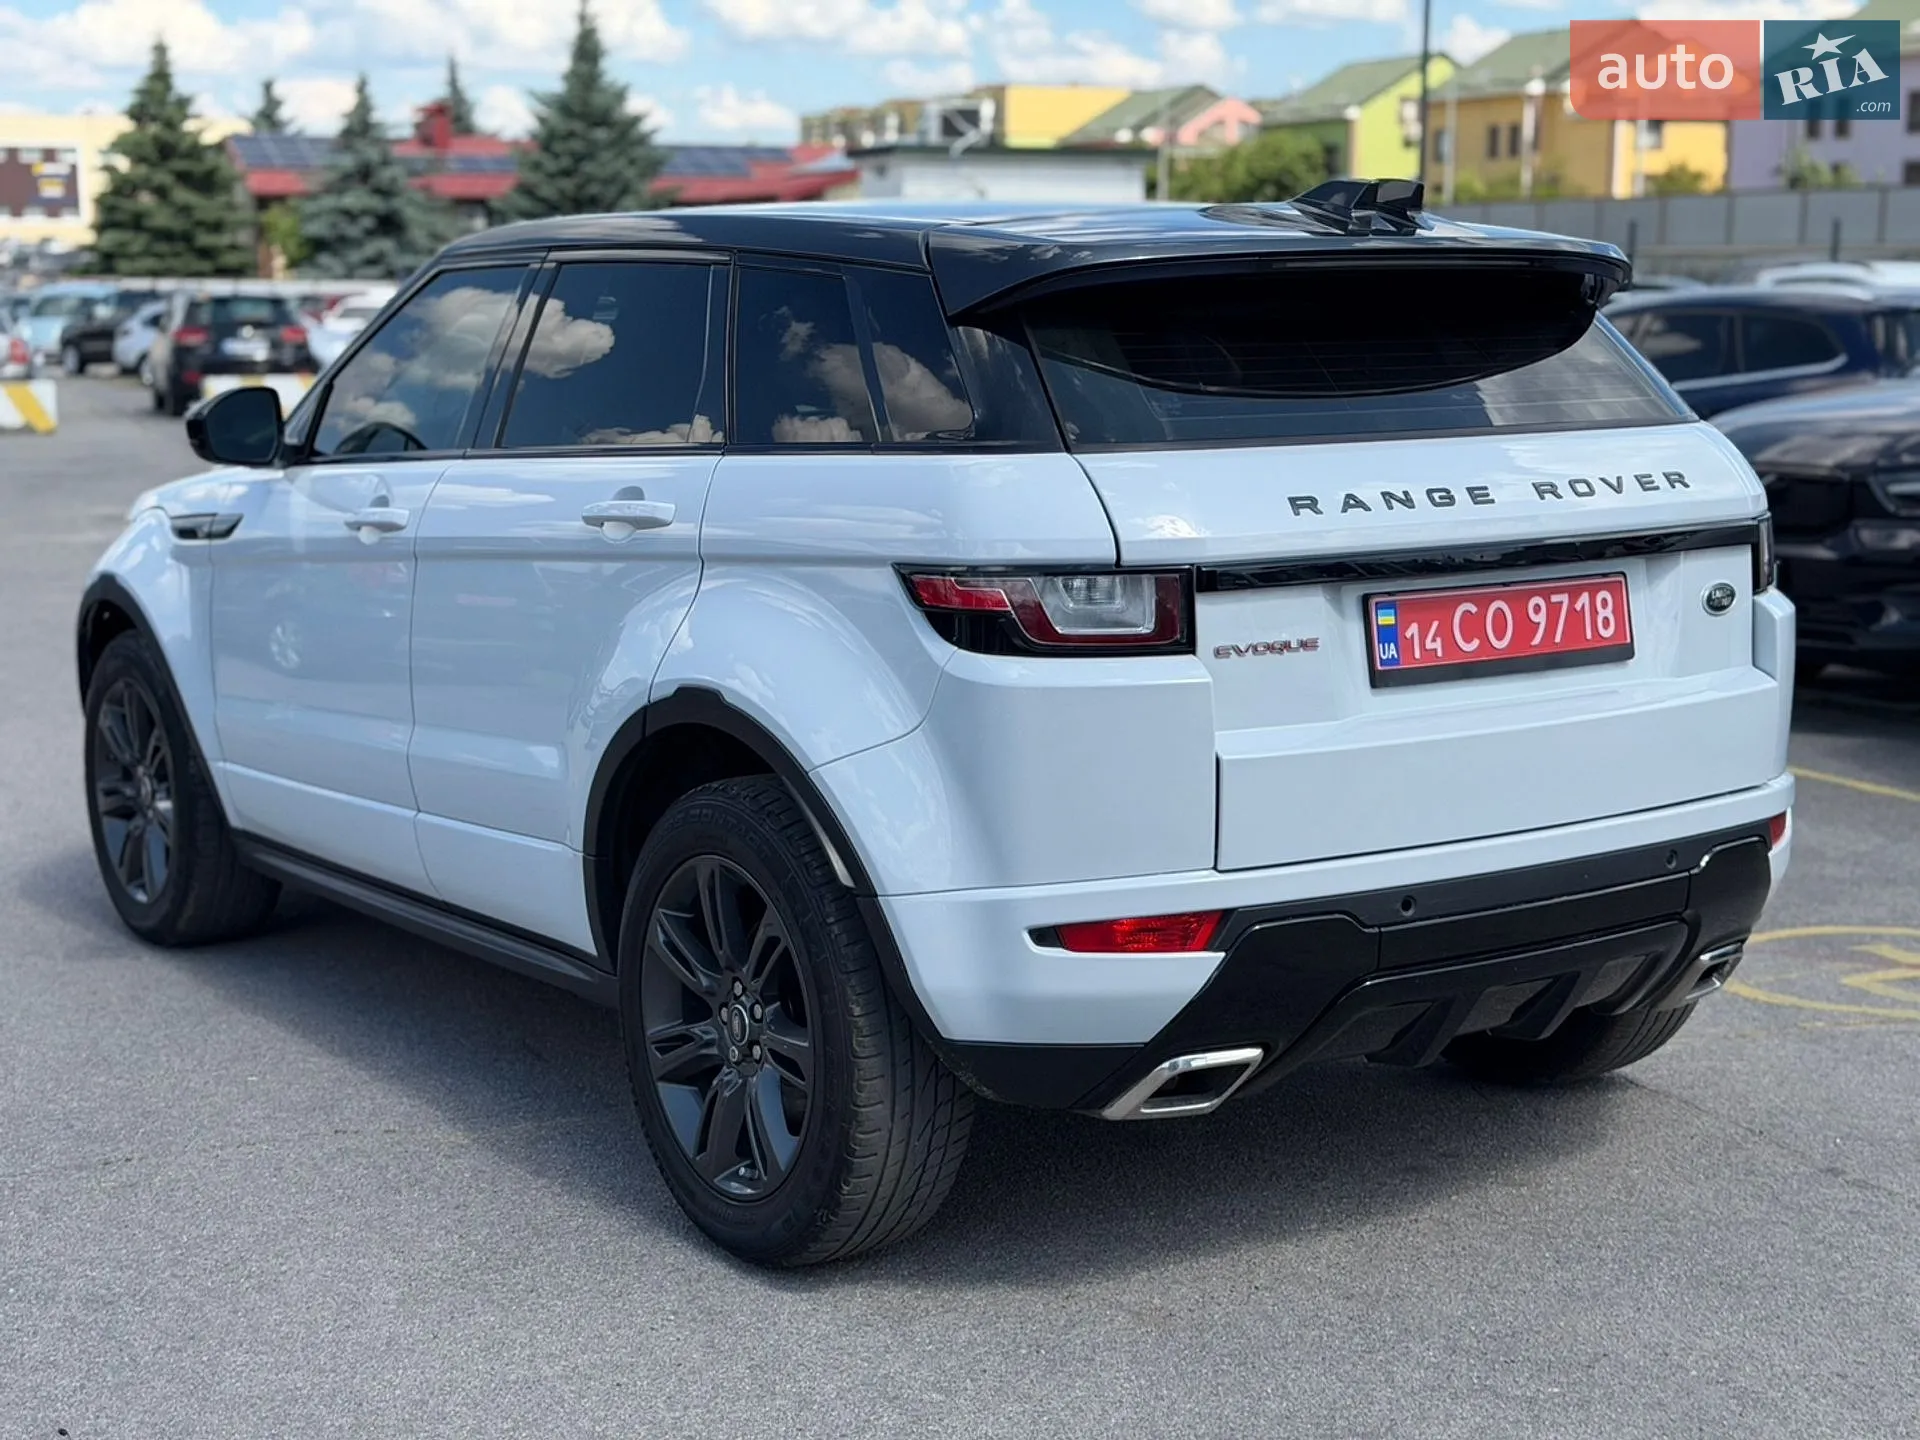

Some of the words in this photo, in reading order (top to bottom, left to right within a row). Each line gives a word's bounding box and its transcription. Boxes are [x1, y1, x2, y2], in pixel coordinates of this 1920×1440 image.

[1287, 485, 1496, 517] RANGE
[1532, 470, 1691, 501] ROVER
[1527, 590, 1616, 647] 9718
[1213, 637, 1320, 659] EVOQUE
[1379, 642, 1398, 660] UA
